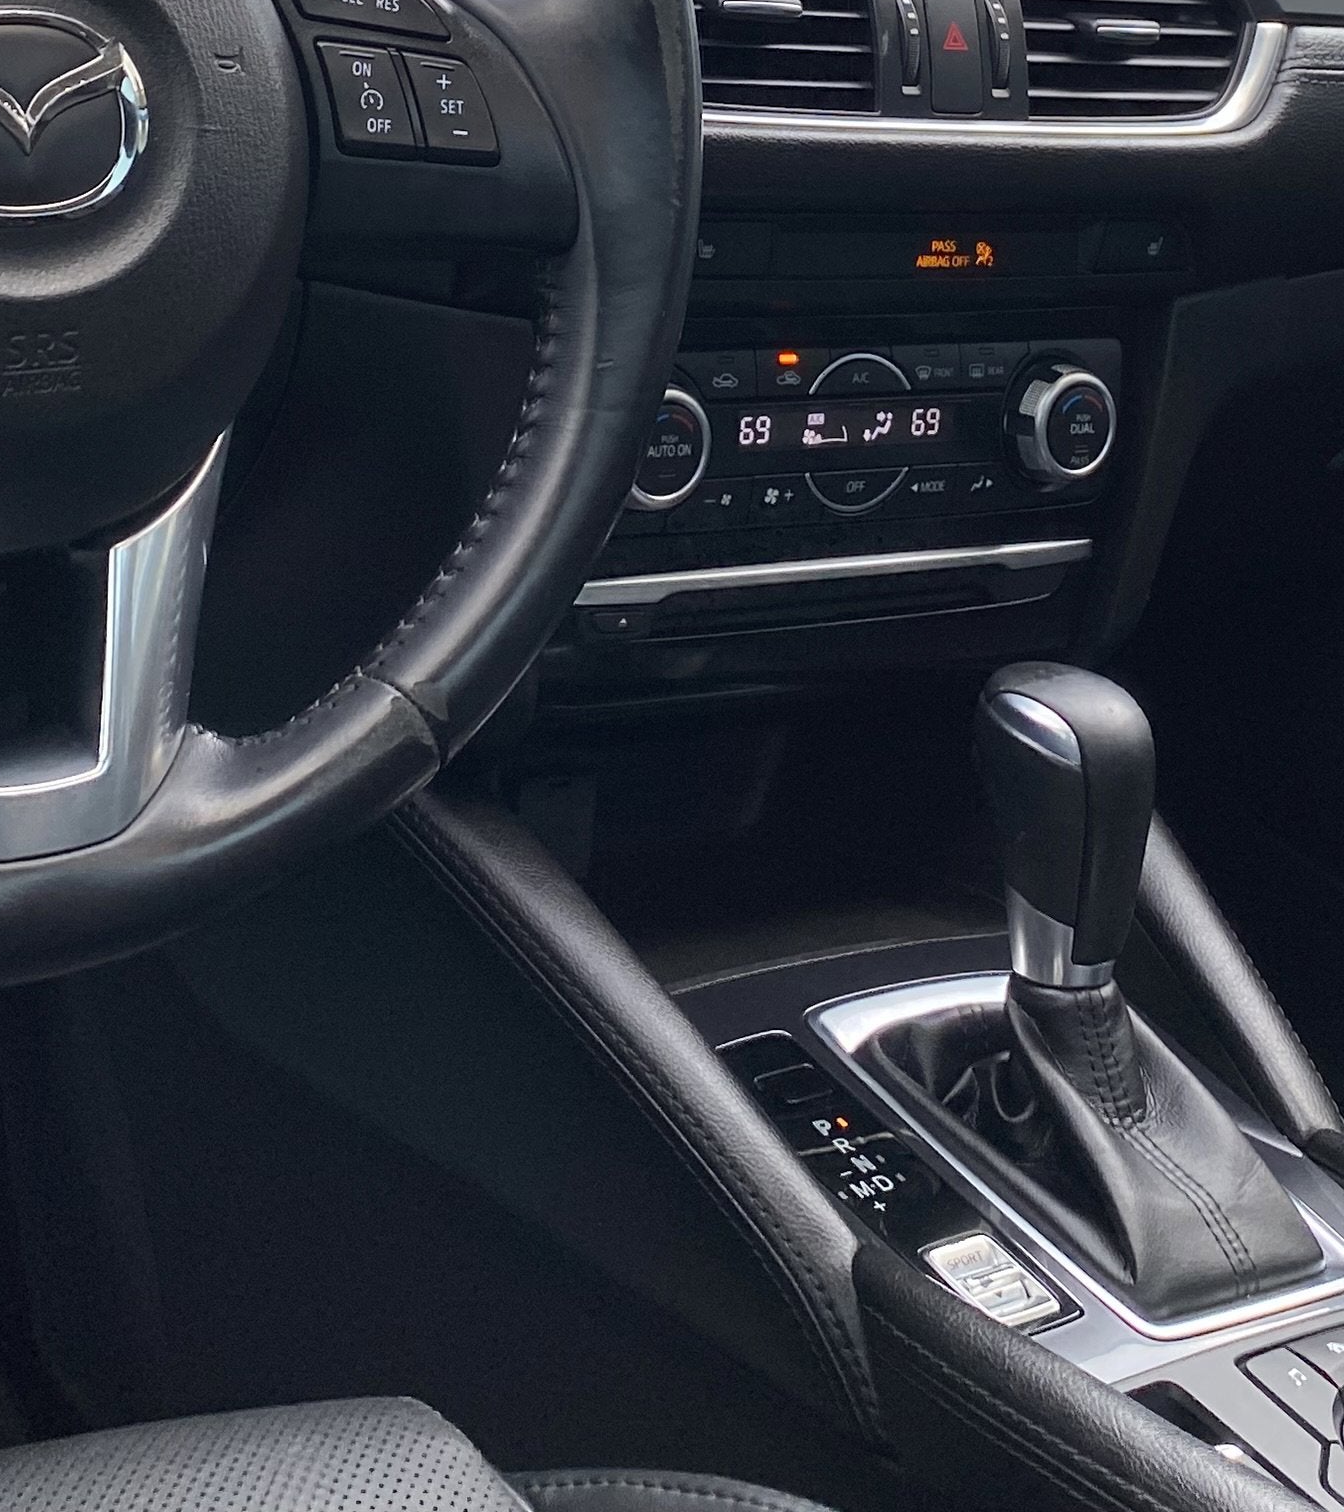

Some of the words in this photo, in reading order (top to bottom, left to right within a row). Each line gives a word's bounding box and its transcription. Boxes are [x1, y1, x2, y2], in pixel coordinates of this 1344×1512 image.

[352, 61, 372, 77] ON
[440, 100, 464, 114] SET
[367, 118, 392, 133] OFF
[931, 240, 956, 252] PASS
[916, 255, 950, 268] AIRBAG
[951, 255, 970, 267] OFF
[852, 373, 870, 384] A/C
[911, 408, 941, 436] 69
[1070, 423, 1095, 434] DUAL
[739, 415, 771, 445] 69
[647, 445, 676, 458] AUTO
[677, 444, 692, 457] ON
[846, 481, 866, 493] OFF
[920, 480, 946, 493] MODE
[812, 1119, 832, 1136] P
[832, 1138, 856, 1154] R
[850, 1154, 878, 1174] N
[946, 1250, 984, 1270] SPORT
